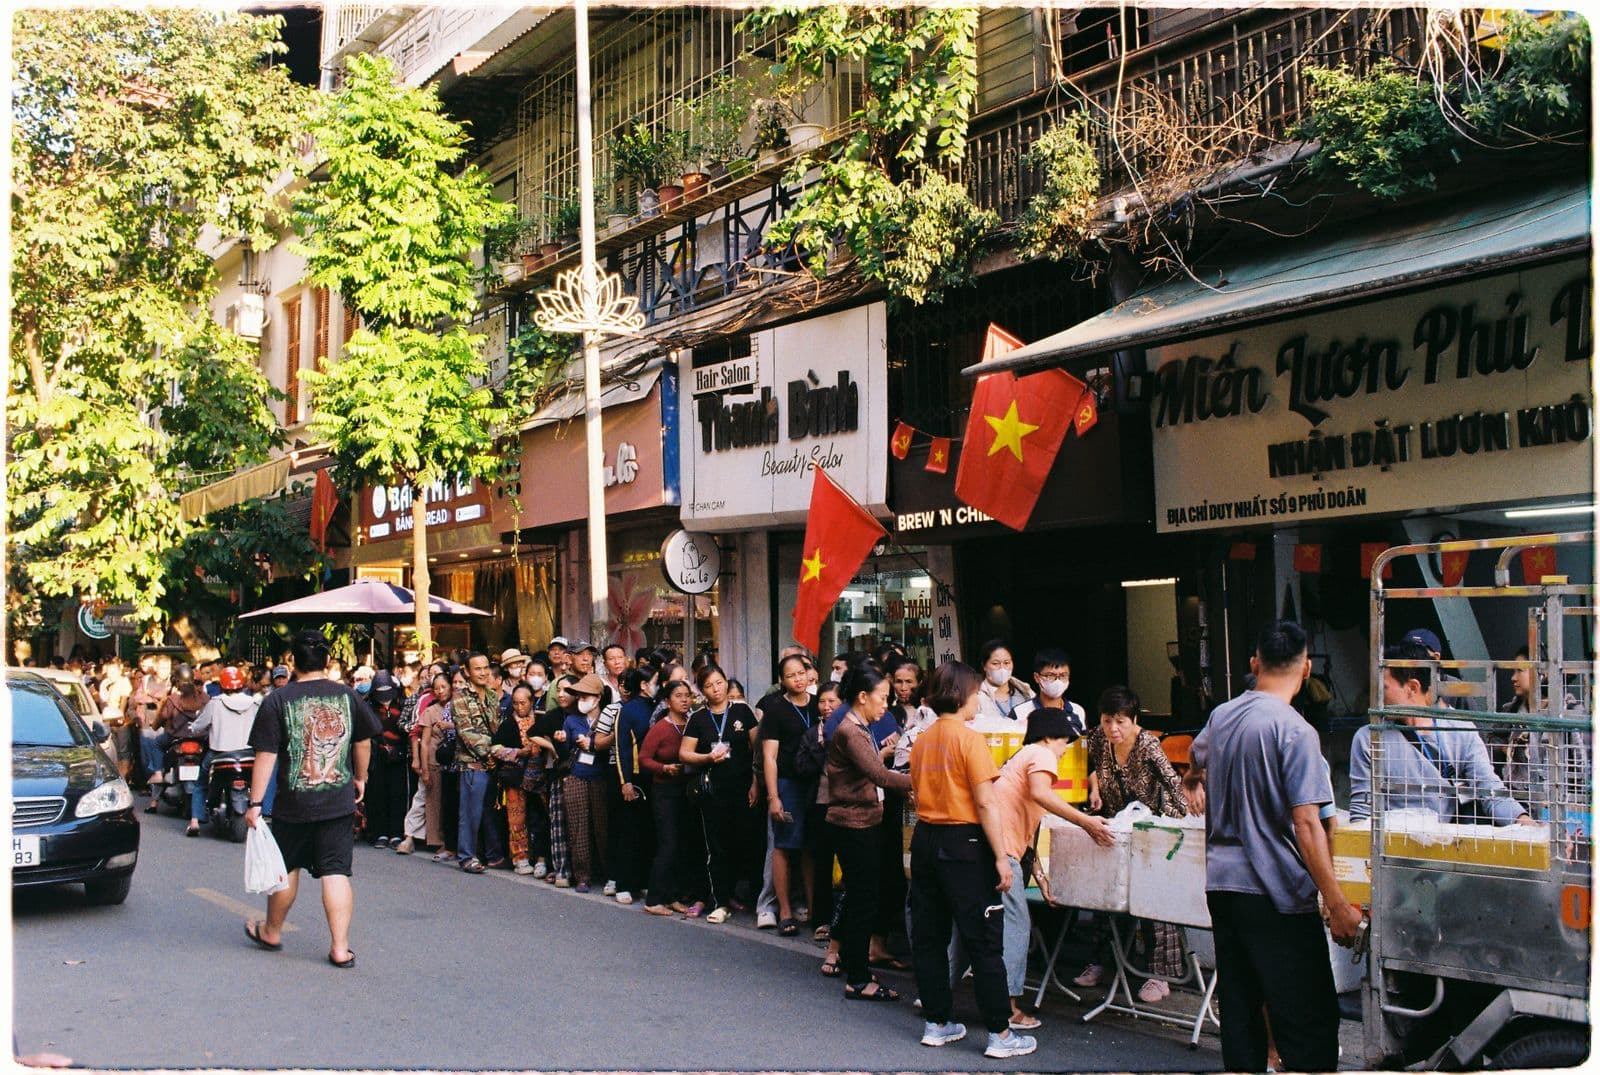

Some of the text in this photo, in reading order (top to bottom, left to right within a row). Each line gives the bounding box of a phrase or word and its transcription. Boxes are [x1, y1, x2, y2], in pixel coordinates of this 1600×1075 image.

[1155, 342, 1270, 428] Miến
[1276, 332, 1411, 427] Lươn
[1414, 291, 1539, 385] Phủ
[696, 363, 750, 391] Hair Salon
[788, 368, 858, 440] Bình
[1268, 429, 1346, 481] NHẬN
[1351, 419, 1413, 472] ĐẶT
[1420, 411, 1509, 459] LƯƠN
[762, 450, 806, 479] Beauty
[424, 507, 448, 526] READ
[898, 511, 935, 531] BREW
[956, 506, 994, 524] CHIL
[1167, 486, 1366, 526] ĐỊA CHỈ DUY NHẤT SỐ 9 PHỦ DOÃN
[13, 839, 21, 850] H
[15, 852, 32, 864] 83
